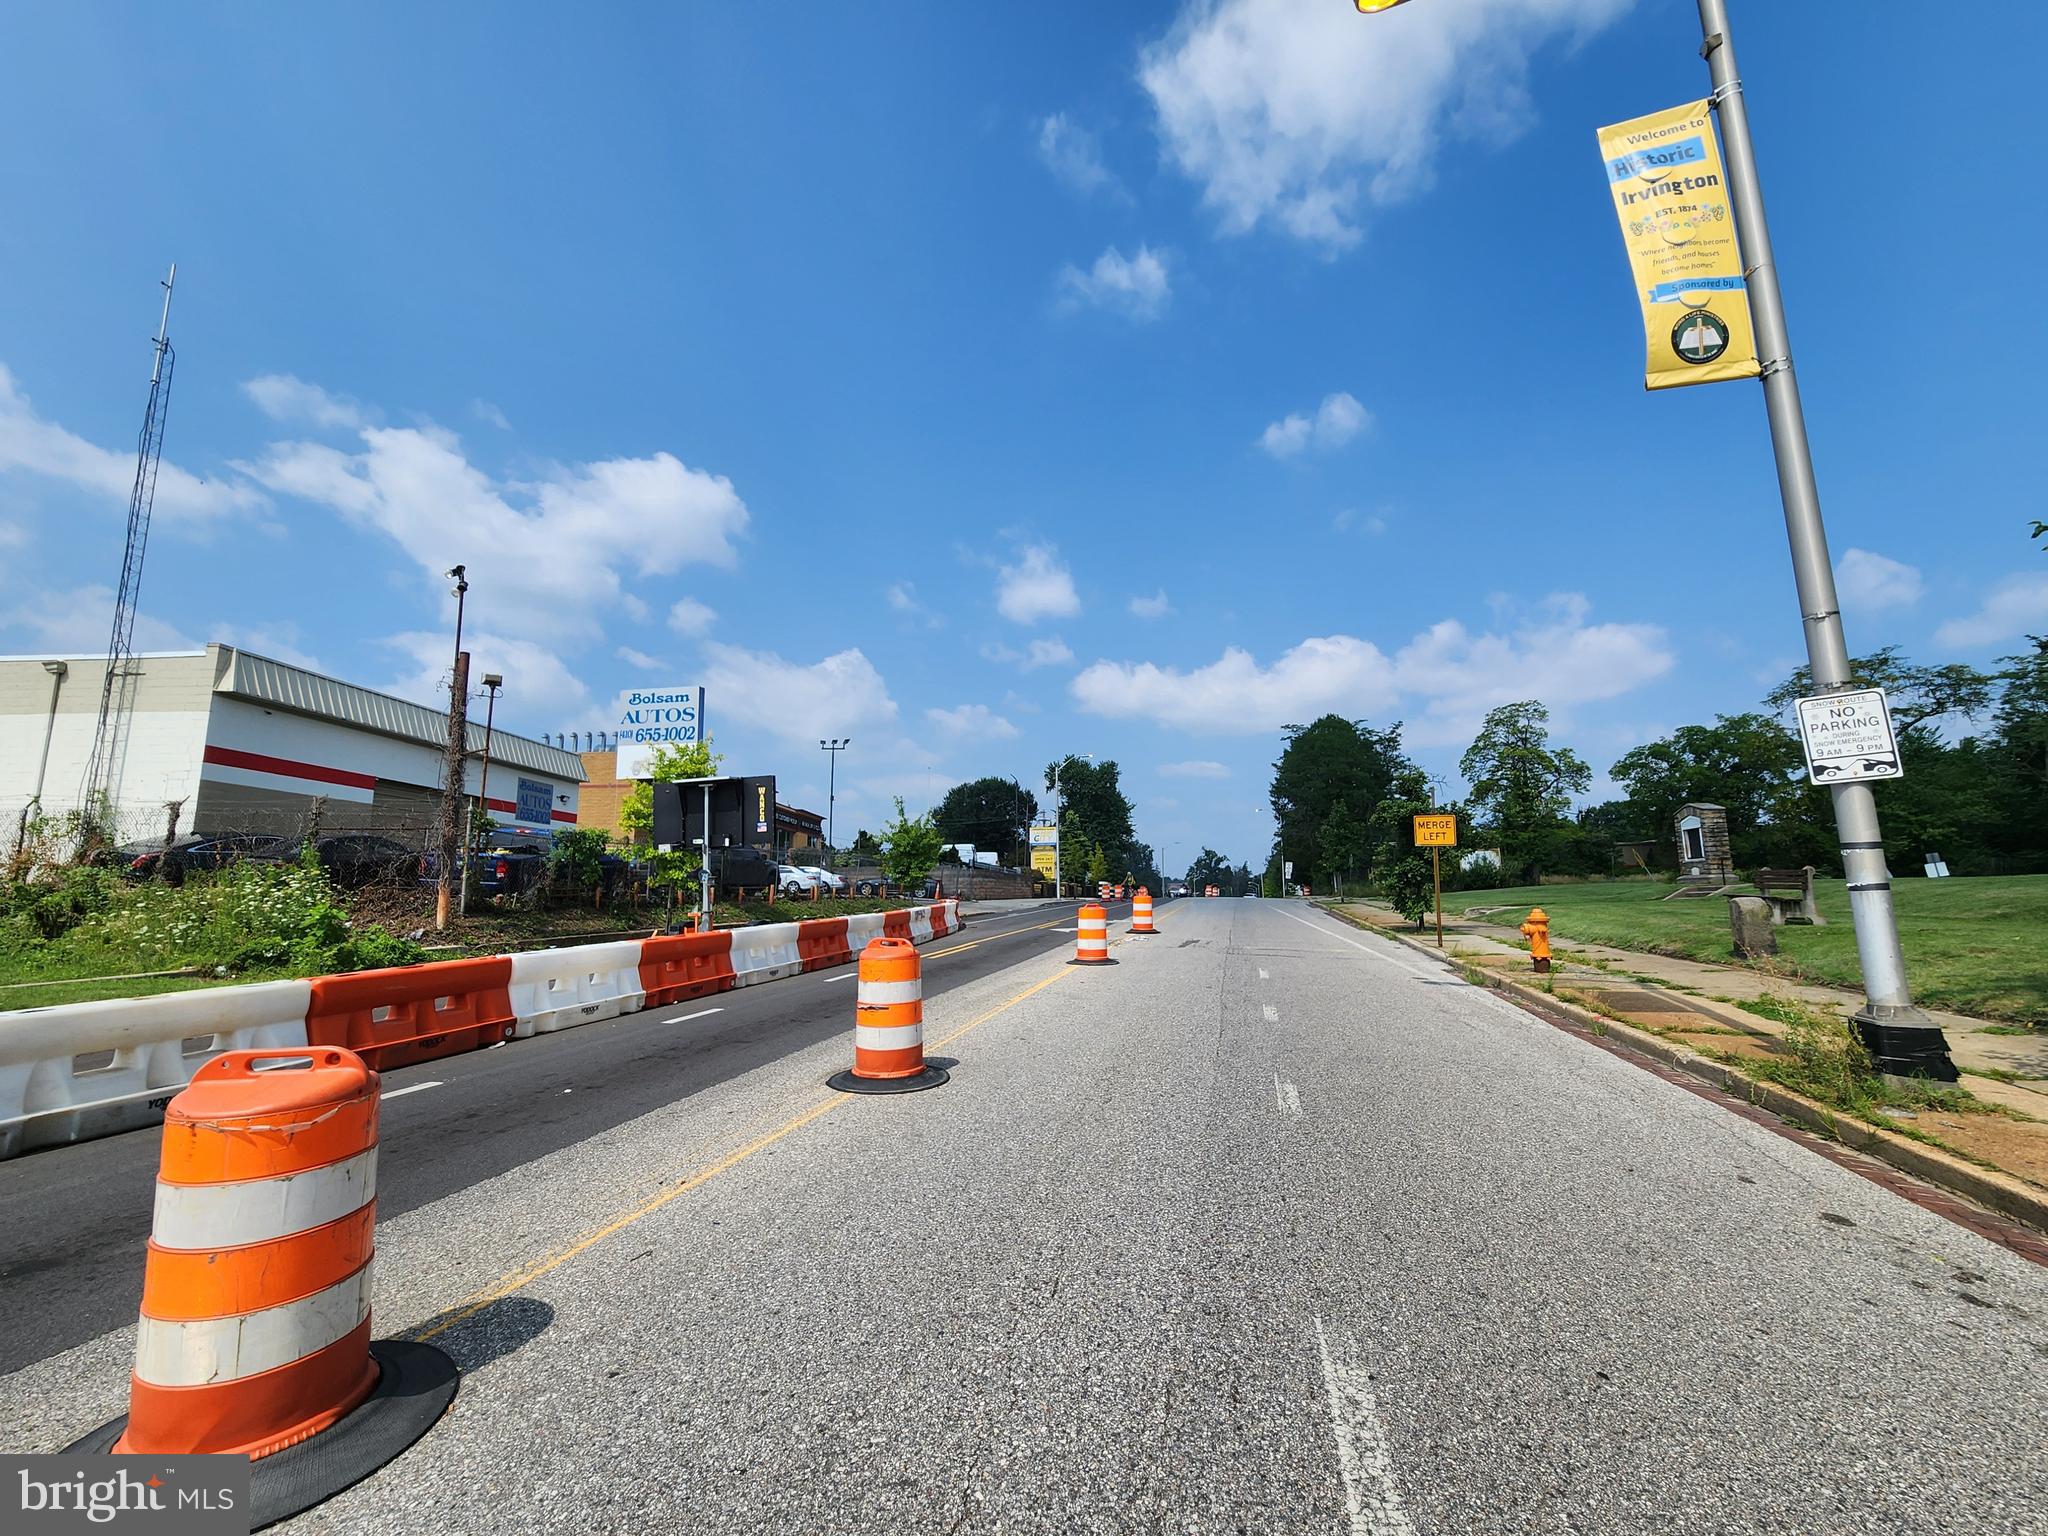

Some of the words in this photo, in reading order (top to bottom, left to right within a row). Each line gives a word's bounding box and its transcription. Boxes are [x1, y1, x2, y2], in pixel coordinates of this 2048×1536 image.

[1627, 124, 1686, 145] Welcome
[1690, 118, 1704, 129] to
[1614, 146, 1695, 177] Historic
[1621, 174, 1719, 206] Irvington
[1655, 207, 1676, 218] EST.
[1703, 238, 1730, 246] become
[1652, 255, 1681, 267] friends,
[1681, 251, 1696, 260] and
[1661, 265, 1690, 275] become
[1671, 279, 1721, 293] Sponsored
[1723, 278, 1734, 288] by
[629, 692, 690, 705] Bolsam
[1810, 700, 1835, 708] SNOW
[621, 707, 695, 725] AUTOS
[1829, 706, 1855, 719] NO
[1810, 716, 1879, 733] PARKING
[635, 726, 696, 742] 655-1002
[1832, 730, 1860, 739] DURING
[1814, 740, 1835, 748] SNOW
[1837, 735, 1883, 745] EMERGENCY
[1816, 748, 1824, 757] 9
[1856, 744, 1864, 753] 9
[1867, 743, 1884, 751] PM
[519, 794, 552, 812] AUTOS
[758, 786, 766, 822] WANCO
[1418, 820, 1452, 830] MERGE
[1423, 831, 1447, 841] LEFT
[148, 1096, 173, 1110] YOD
